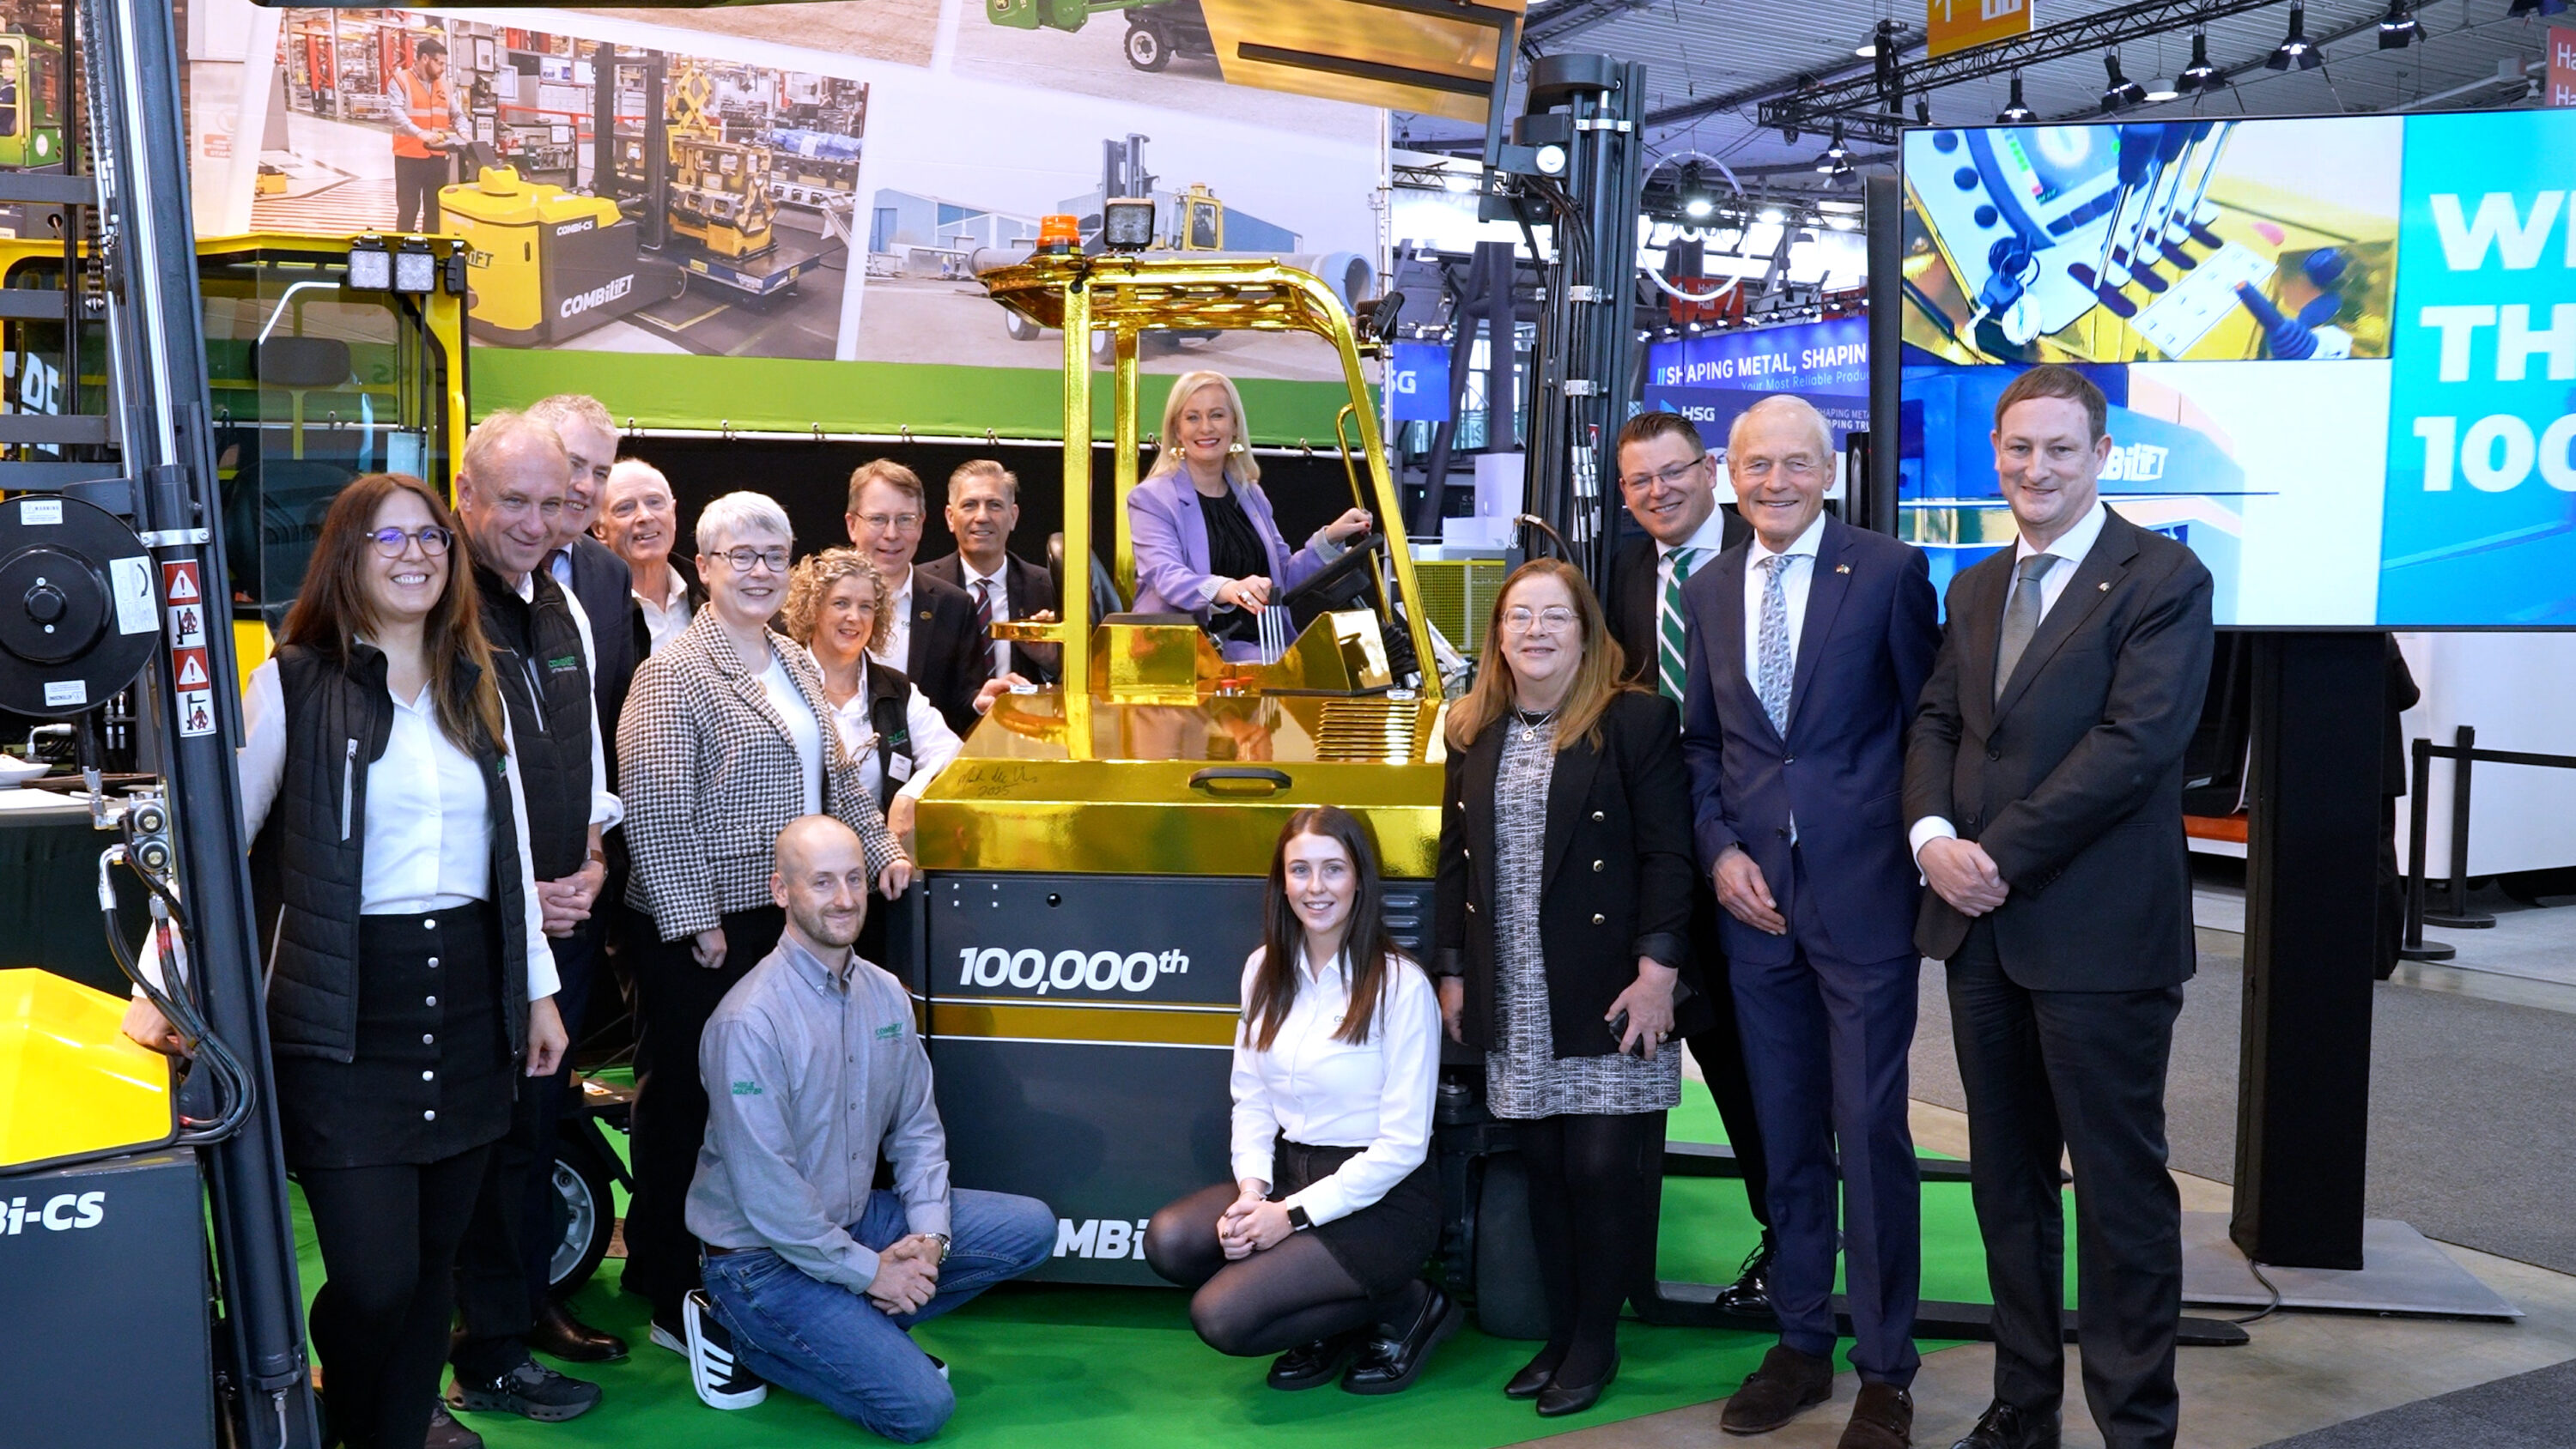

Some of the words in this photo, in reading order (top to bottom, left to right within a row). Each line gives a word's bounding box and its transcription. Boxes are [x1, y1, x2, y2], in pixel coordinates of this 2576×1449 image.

[2429, 190, 2576, 270] W
[1667, 358, 1734, 385] SHAPING
[1738, 353, 1796, 376] METAL,
[1801, 343, 1868, 369] SHAPIN
[1793, 372, 1833, 386] Reliable
[1682, 406, 1716, 421] HSG
[959, 947, 1190, 995] 100,000th
[0, 1191, 105, 1235] i-CS
